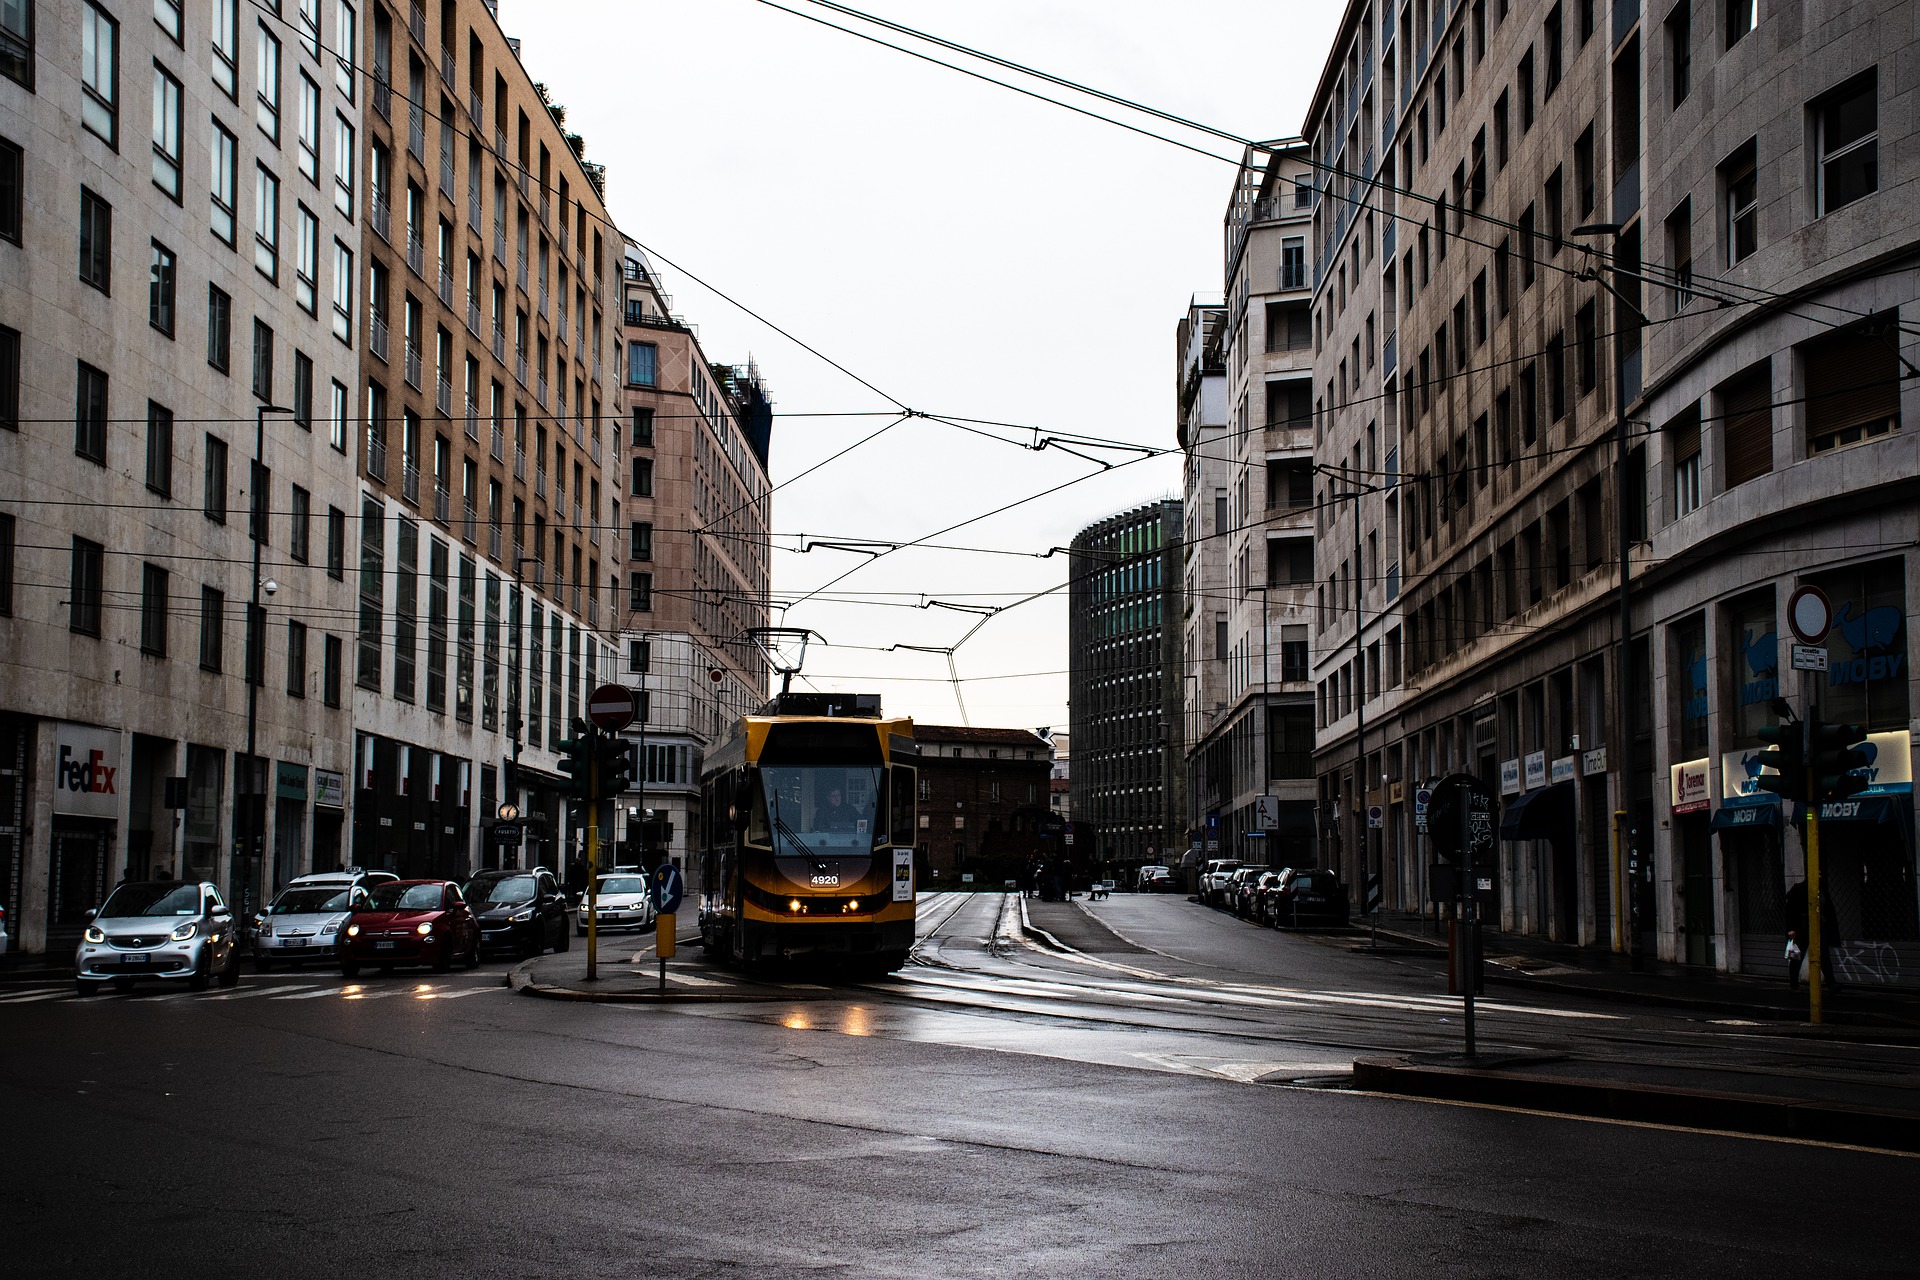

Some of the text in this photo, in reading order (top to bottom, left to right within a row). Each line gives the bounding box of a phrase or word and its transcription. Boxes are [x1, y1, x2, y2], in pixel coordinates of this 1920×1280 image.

[1801, 647, 1819, 655] eccetto
[1829, 652, 1905, 688] MOBY
[59, 745, 116, 794] FedEx
[1685, 773, 1705, 789] Toremar
[1741, 780, 1760, 794] MOB
[1732, 808, 1757, 824] MOBY
[1821, 801, 1861, 817] MOBY
[811, 876, 838, 884] 4920
